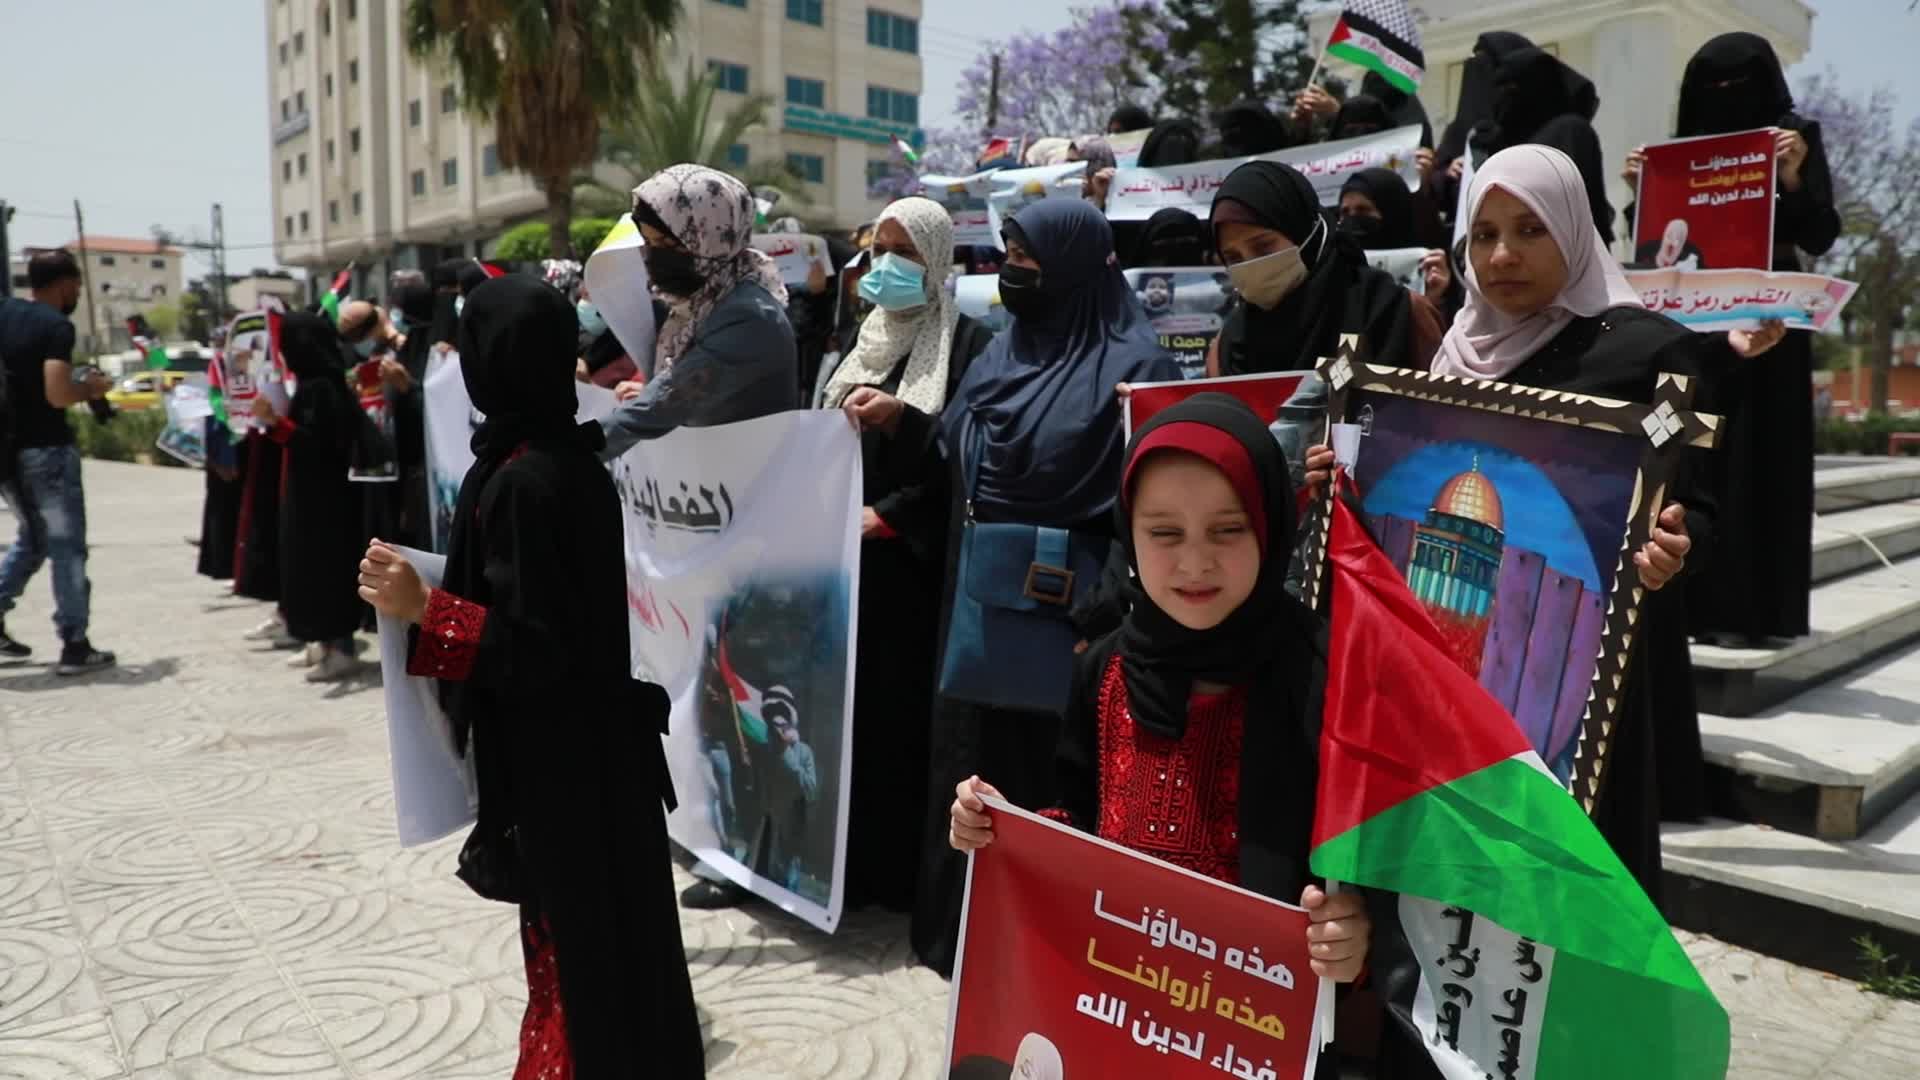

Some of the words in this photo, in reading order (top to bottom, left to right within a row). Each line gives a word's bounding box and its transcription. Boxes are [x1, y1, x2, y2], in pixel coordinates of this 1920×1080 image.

[1094, 889, 1217, 960] دماؤنا
[1087, 937, 1212, 1012] أرواحنا
[1223, 946, 1295, 990] هذه
[1075, 992, 1127, 1029] الله
[1215, 997, 1285, 1041] هذه
[1131, 1010, 1205, 1061] لدين
[1210, 1043, 1277, 1080] فداء
